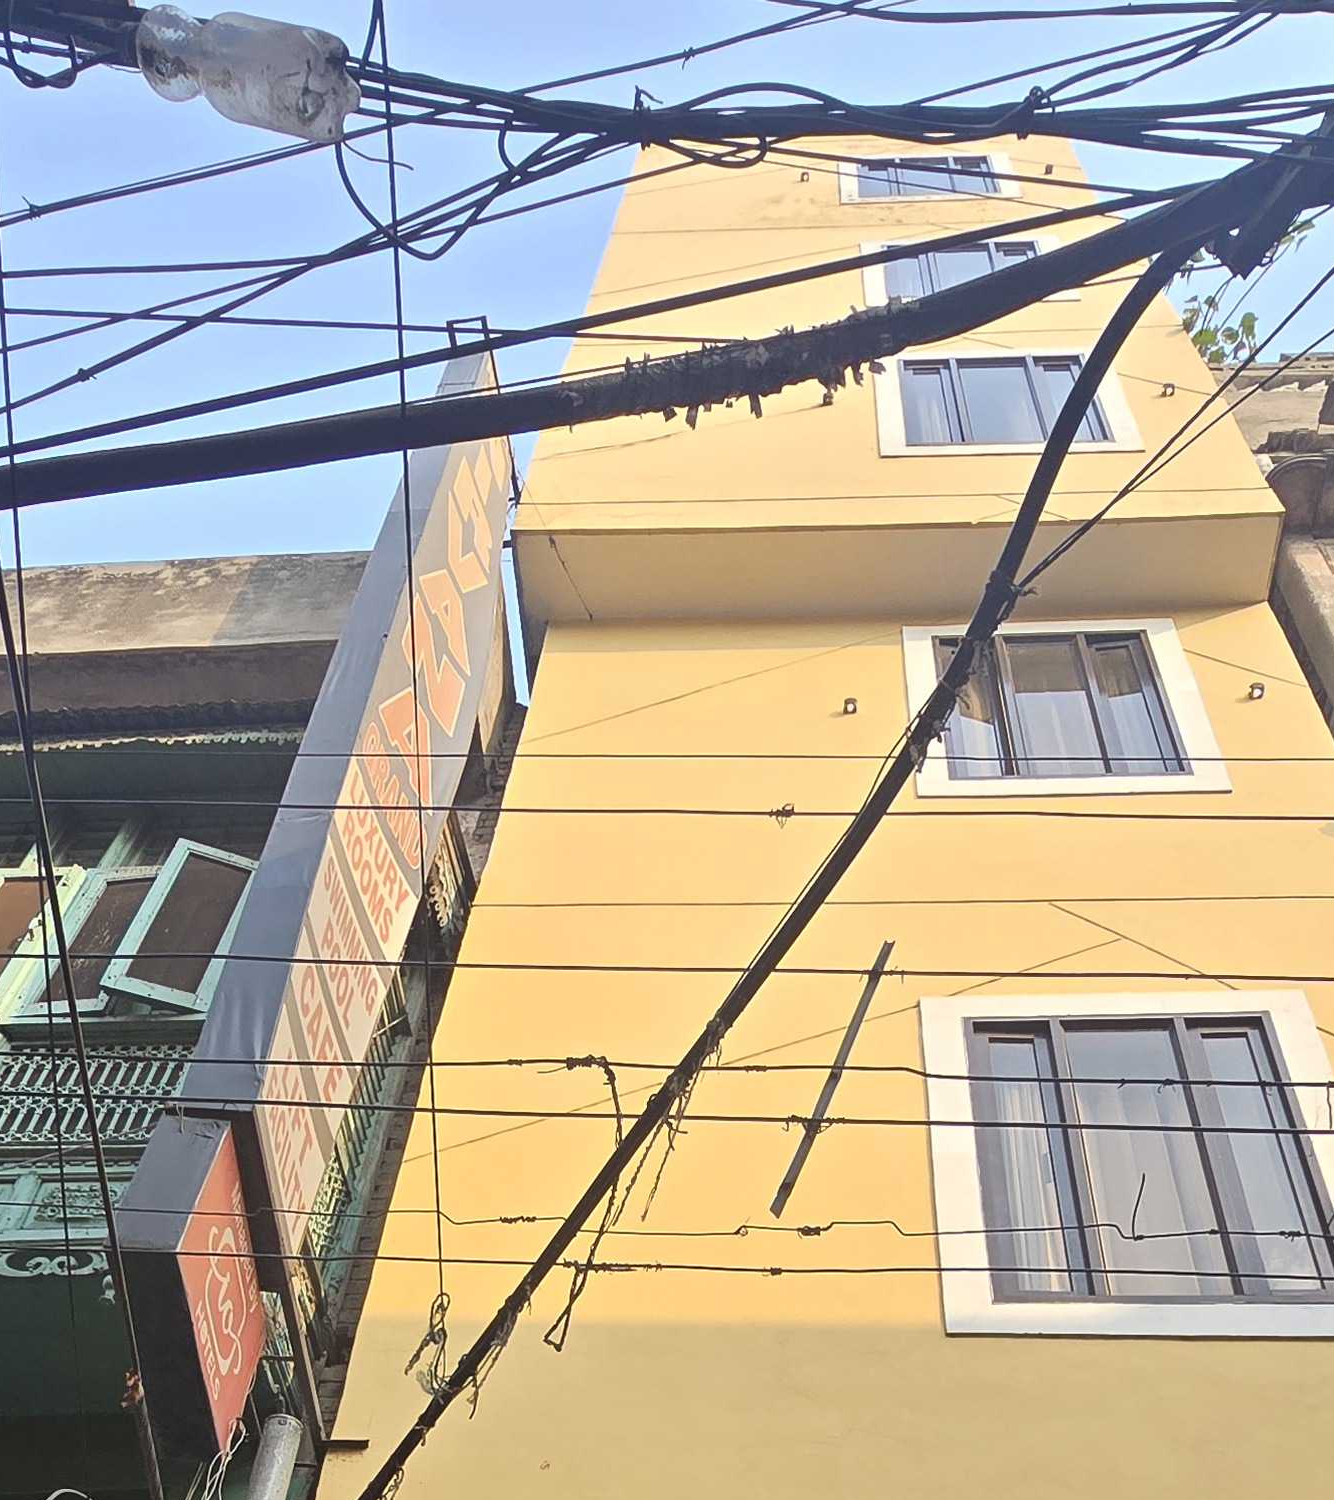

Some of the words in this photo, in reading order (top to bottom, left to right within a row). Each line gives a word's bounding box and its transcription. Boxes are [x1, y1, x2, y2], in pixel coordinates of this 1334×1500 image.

[349, 769, 410, 913] LUXURY
[363, 722, 427, 869] GRAND
[323, 855, 378, 1016] SWIMMING
[343, 813, 393, 945] ROOMS
[300, 965, 343, 1106] CAFE
[322, 918, 355, 1032] POOL
[281, 1049, 313, 1164] LIFT
[195, 1299, 220, 1401] HOTELS
